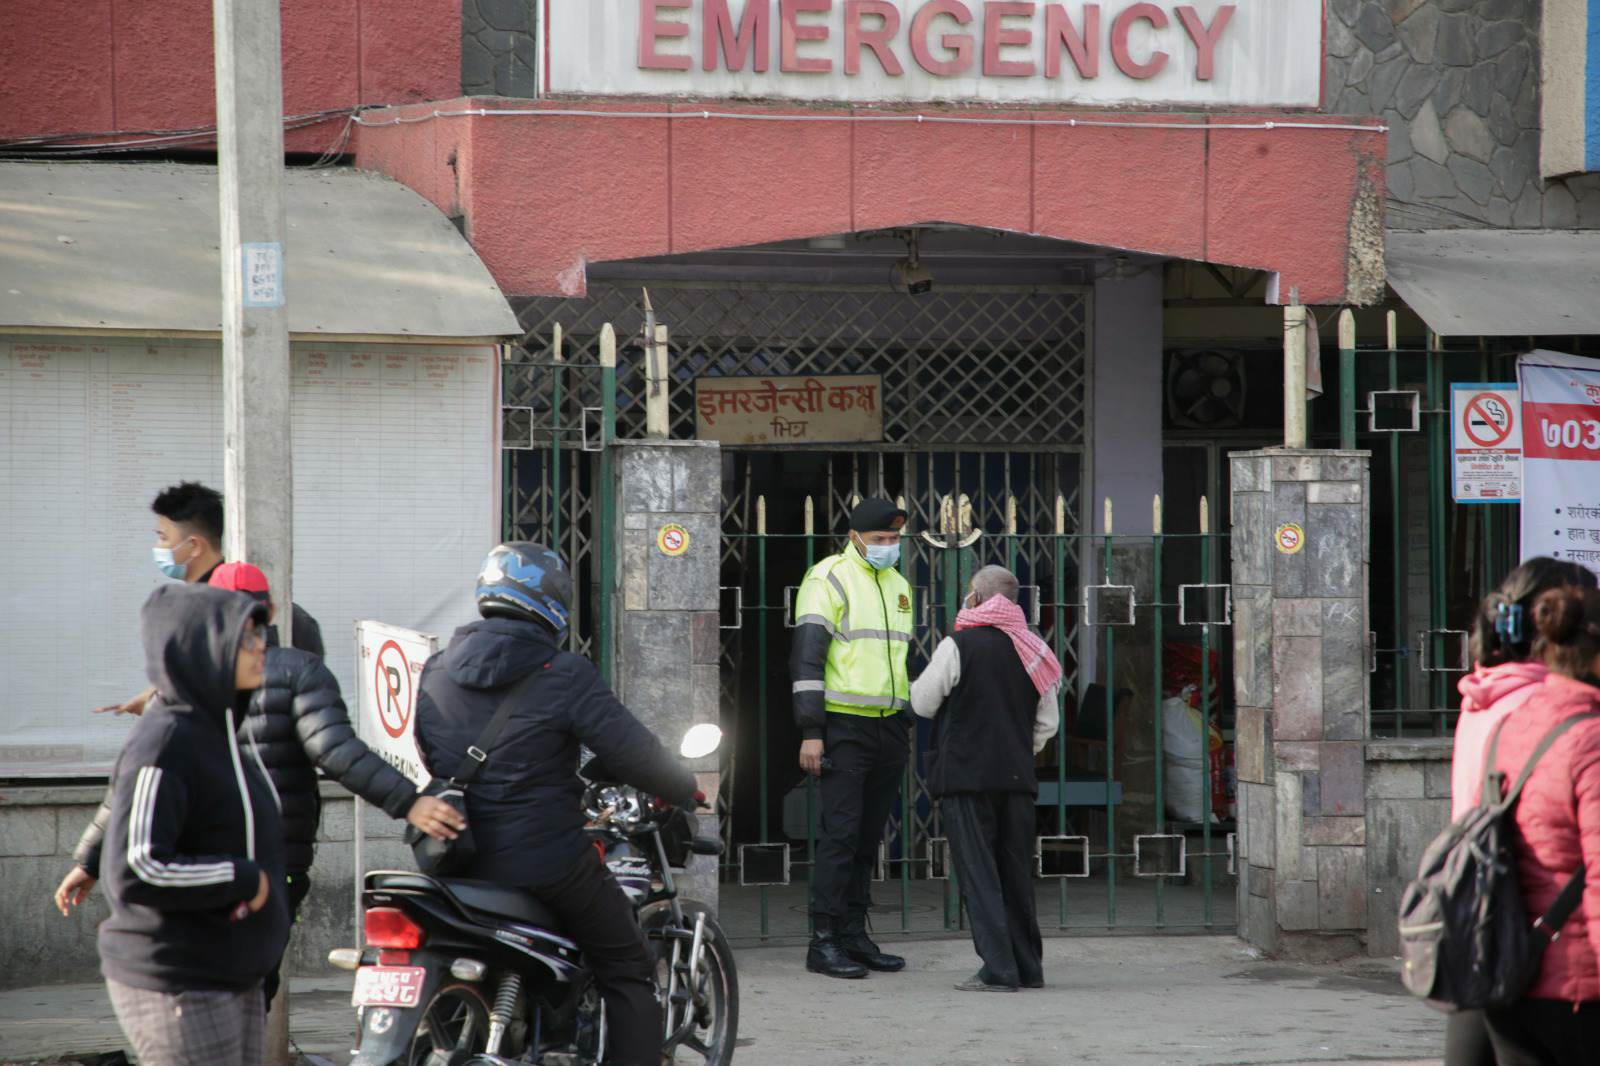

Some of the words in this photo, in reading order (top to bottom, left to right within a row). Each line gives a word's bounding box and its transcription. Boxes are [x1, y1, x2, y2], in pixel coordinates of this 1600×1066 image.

[638, 0, 1236, 81] EMERGENCY
[697, 378, 825, 425] इमरजेन्सी
[828, 385, 877, 412] कक्ष
